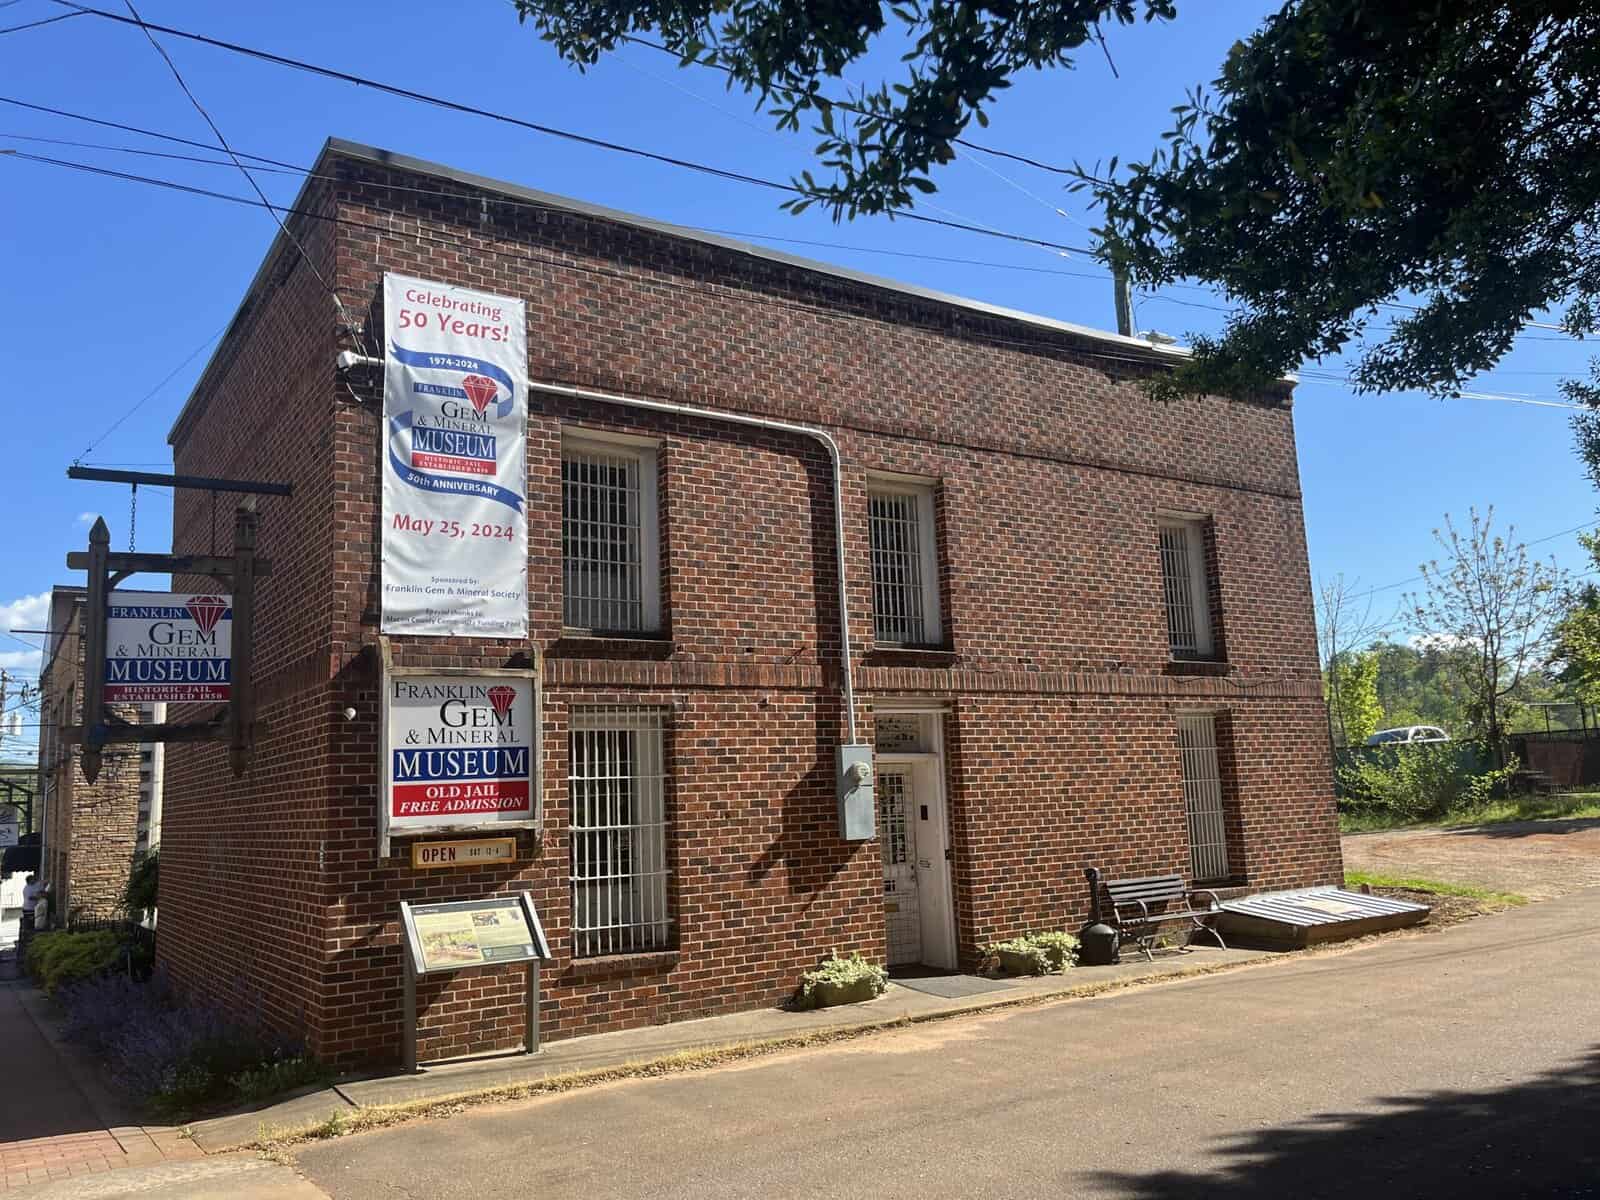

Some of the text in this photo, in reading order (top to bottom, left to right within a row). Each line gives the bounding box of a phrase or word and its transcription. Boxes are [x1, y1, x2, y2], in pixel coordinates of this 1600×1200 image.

[406, 289, 502, 322] Celebrating
[400, 309, 510, 342] 50 Years!
[429, 357, 479, 369] 1974-2024
[418, 383, 463, 396] FRANKLIN
[441, 401, 488, 422] GEM
[417, 416, 495, 435] & MINERAL
[414, 429, 494, 458] MUSEUM
[407, 472, 499, 496] 50th ANNIVERSARY
[393, 513, 514, 541] May 25, 2024
[431, 576, 467, 584] Sponsored
[386, 584, 521, 600] Franklin Gem & Mineral Society
[112, 607, 183, 618] FRANKLIN
[149, 622, 216, 645] GEM
[115, 643, 222, 657] & MINERAL
[110, 660, 226, 680] MUSEUM
[113, 693, 195, 701] ESTABLISHED
[394, 681, 488, 699] FRANKLIN
[440, 699, 514, 728] GEM
[405, 727, 520, 744] & MINERAL
[397, 749, 526, 778] MUSEUM
[426, 784, 499, 799] OLD JAIL
[400, 797, 523, 813] FREE ADMISSION
[422, 847, 456, 863] OPEN
